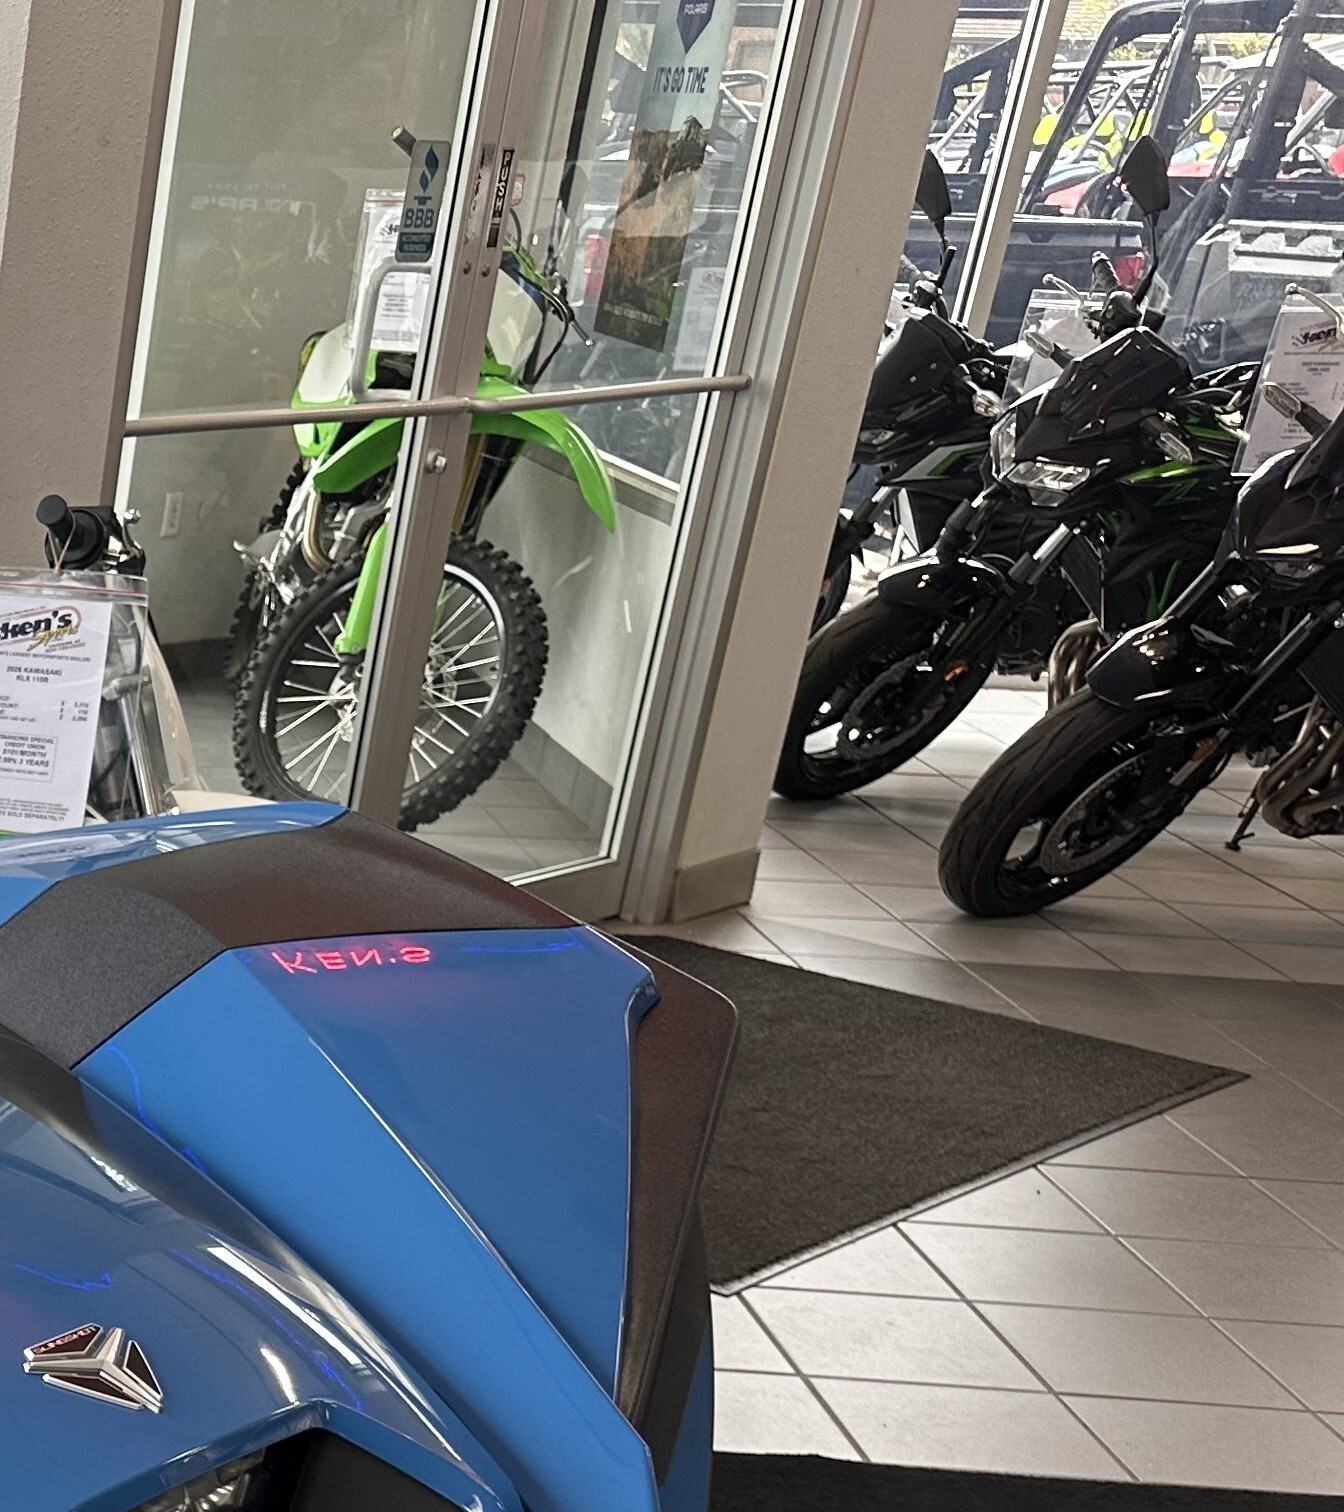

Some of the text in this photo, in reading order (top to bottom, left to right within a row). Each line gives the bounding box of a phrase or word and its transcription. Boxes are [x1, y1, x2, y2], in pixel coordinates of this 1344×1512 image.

[671, 66, 686, 93] GO
[685, 66, 709, 93] TIME
[495, 151, 511, 211] PUSH
[404, 208, 434, 228] BBB
[24, 667, 62, 676] KAWASAKI
[25, 758, 50, 768] YEARS
